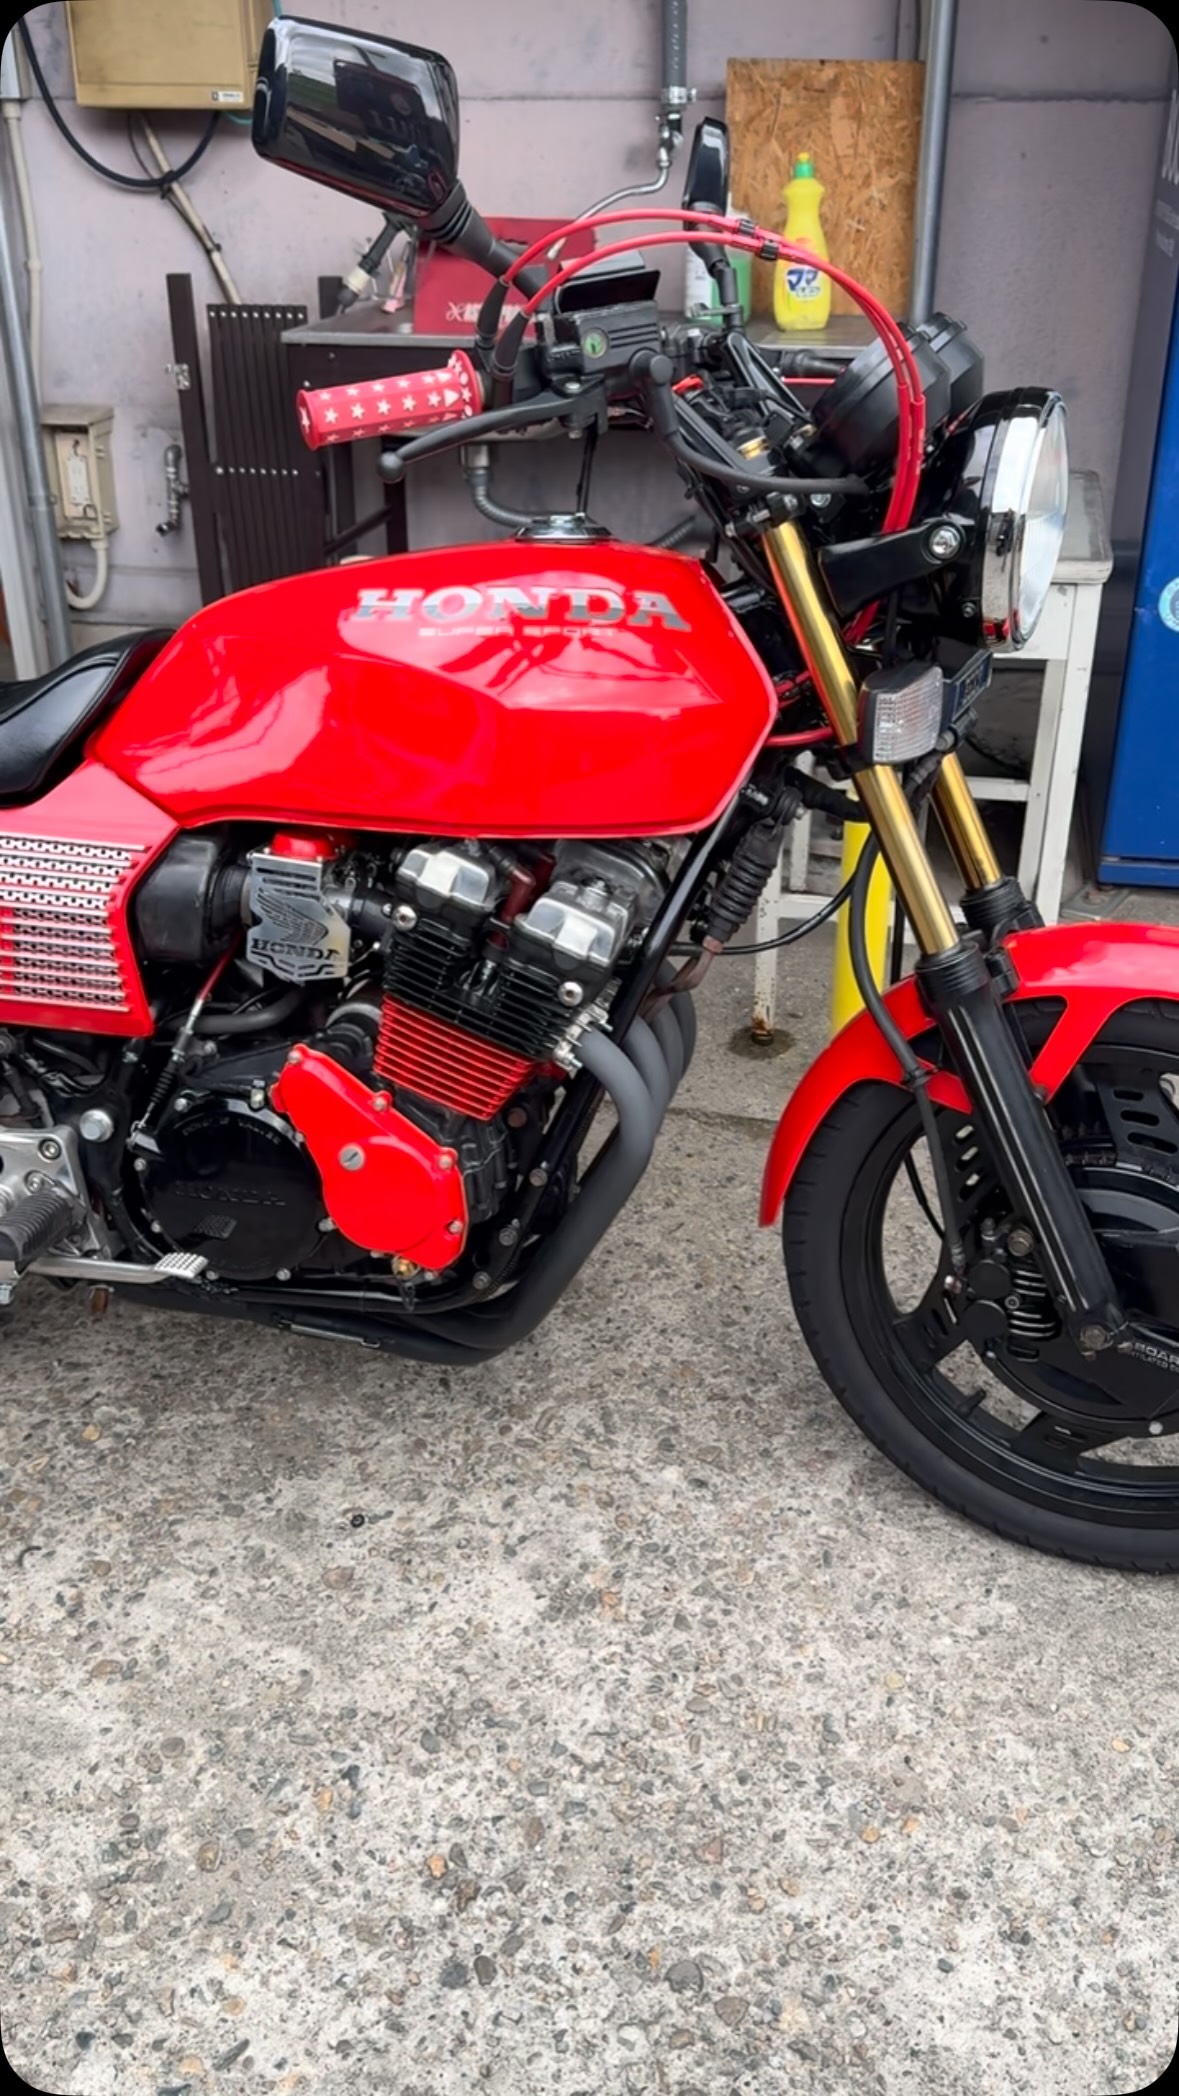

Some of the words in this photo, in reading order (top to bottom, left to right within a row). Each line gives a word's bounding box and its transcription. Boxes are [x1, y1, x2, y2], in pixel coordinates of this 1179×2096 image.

[355, 586, 691, 631] HONDA
[419, 626, 514, 637] SUPER
[251, 938, 340, 960] HONDA
